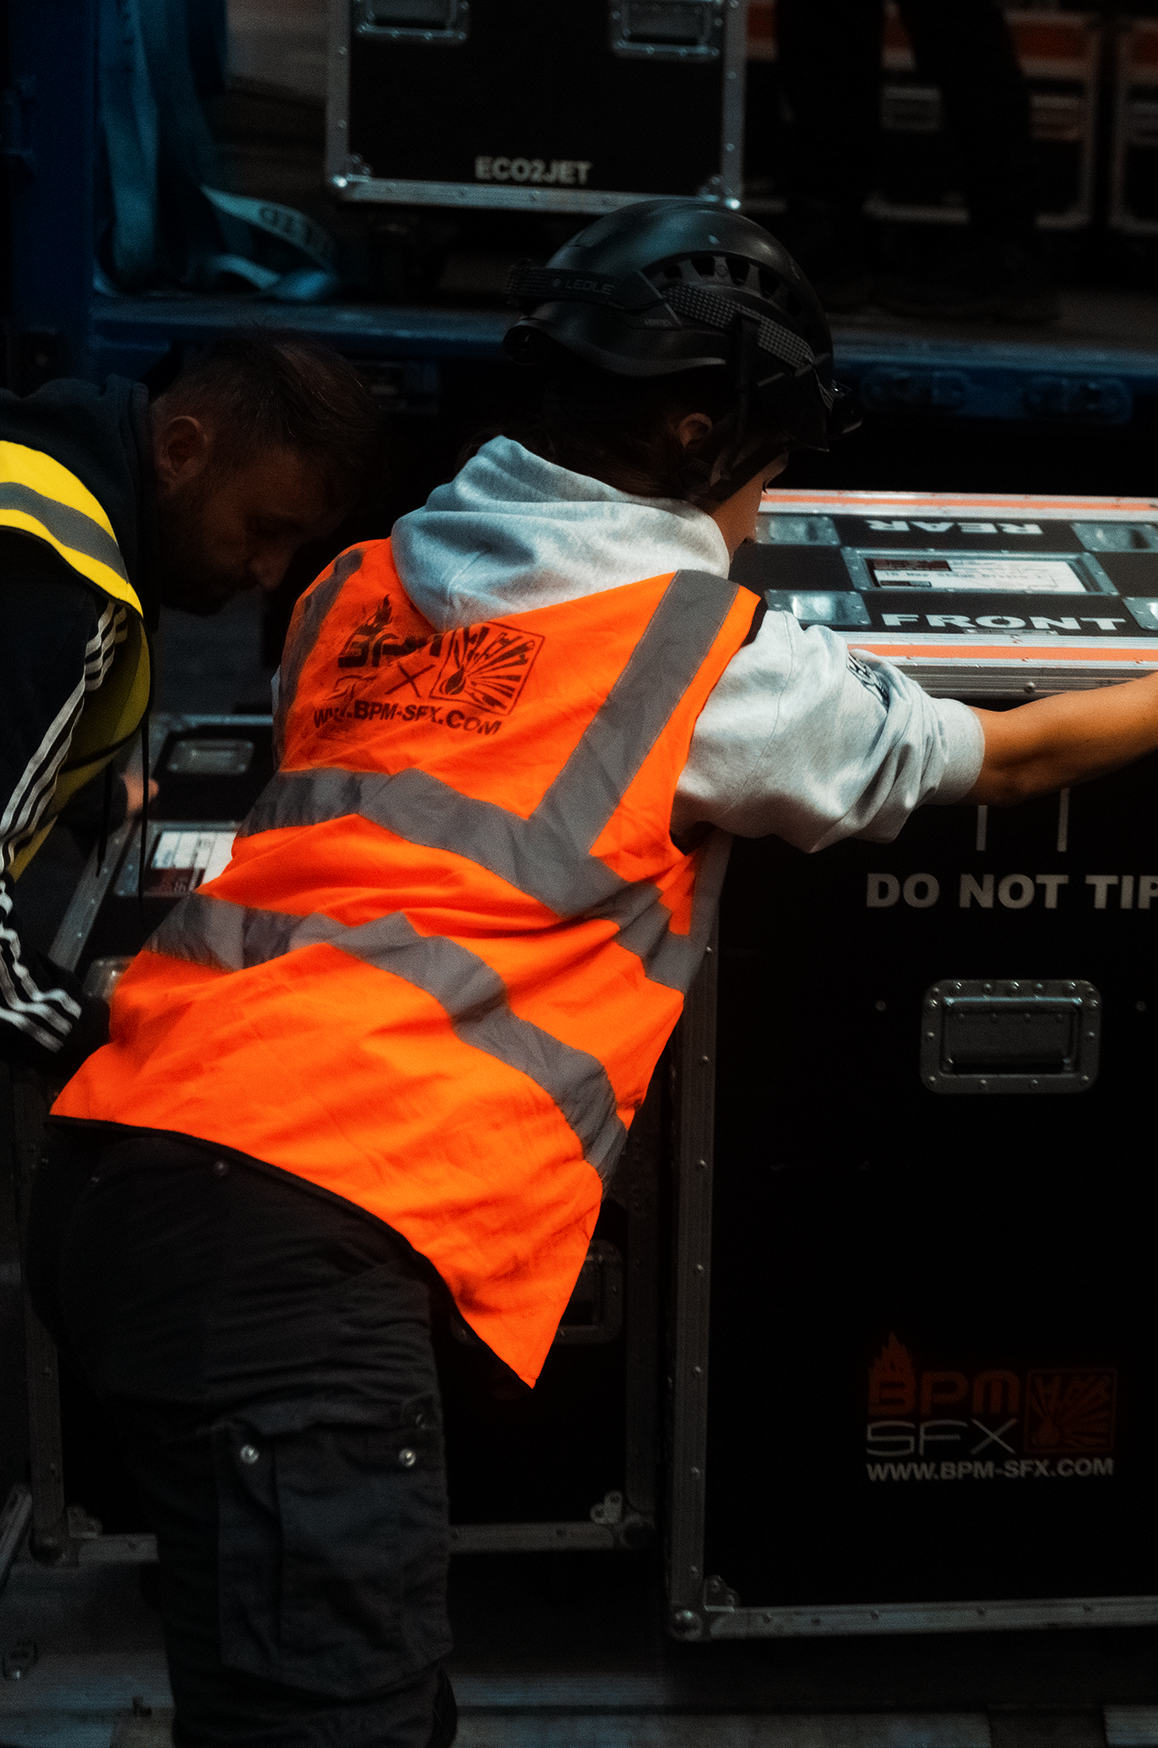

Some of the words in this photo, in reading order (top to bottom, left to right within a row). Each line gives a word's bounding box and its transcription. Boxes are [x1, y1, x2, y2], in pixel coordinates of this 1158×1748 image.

[475, 155, 593, 185] ECO2JET
[866, 520, 1043, 535] REAR
[881, 613, 1126, 630] FRONT
[866, 872, 940, 908] DO
[959, 873, 1070, 909] NOT
[868, 1346, 1021, 1416] BPM
[866, 1418, 1019, 1457] SFX
[866, 1457, 1115, 1482] WWW.BPM-SFX.COM
